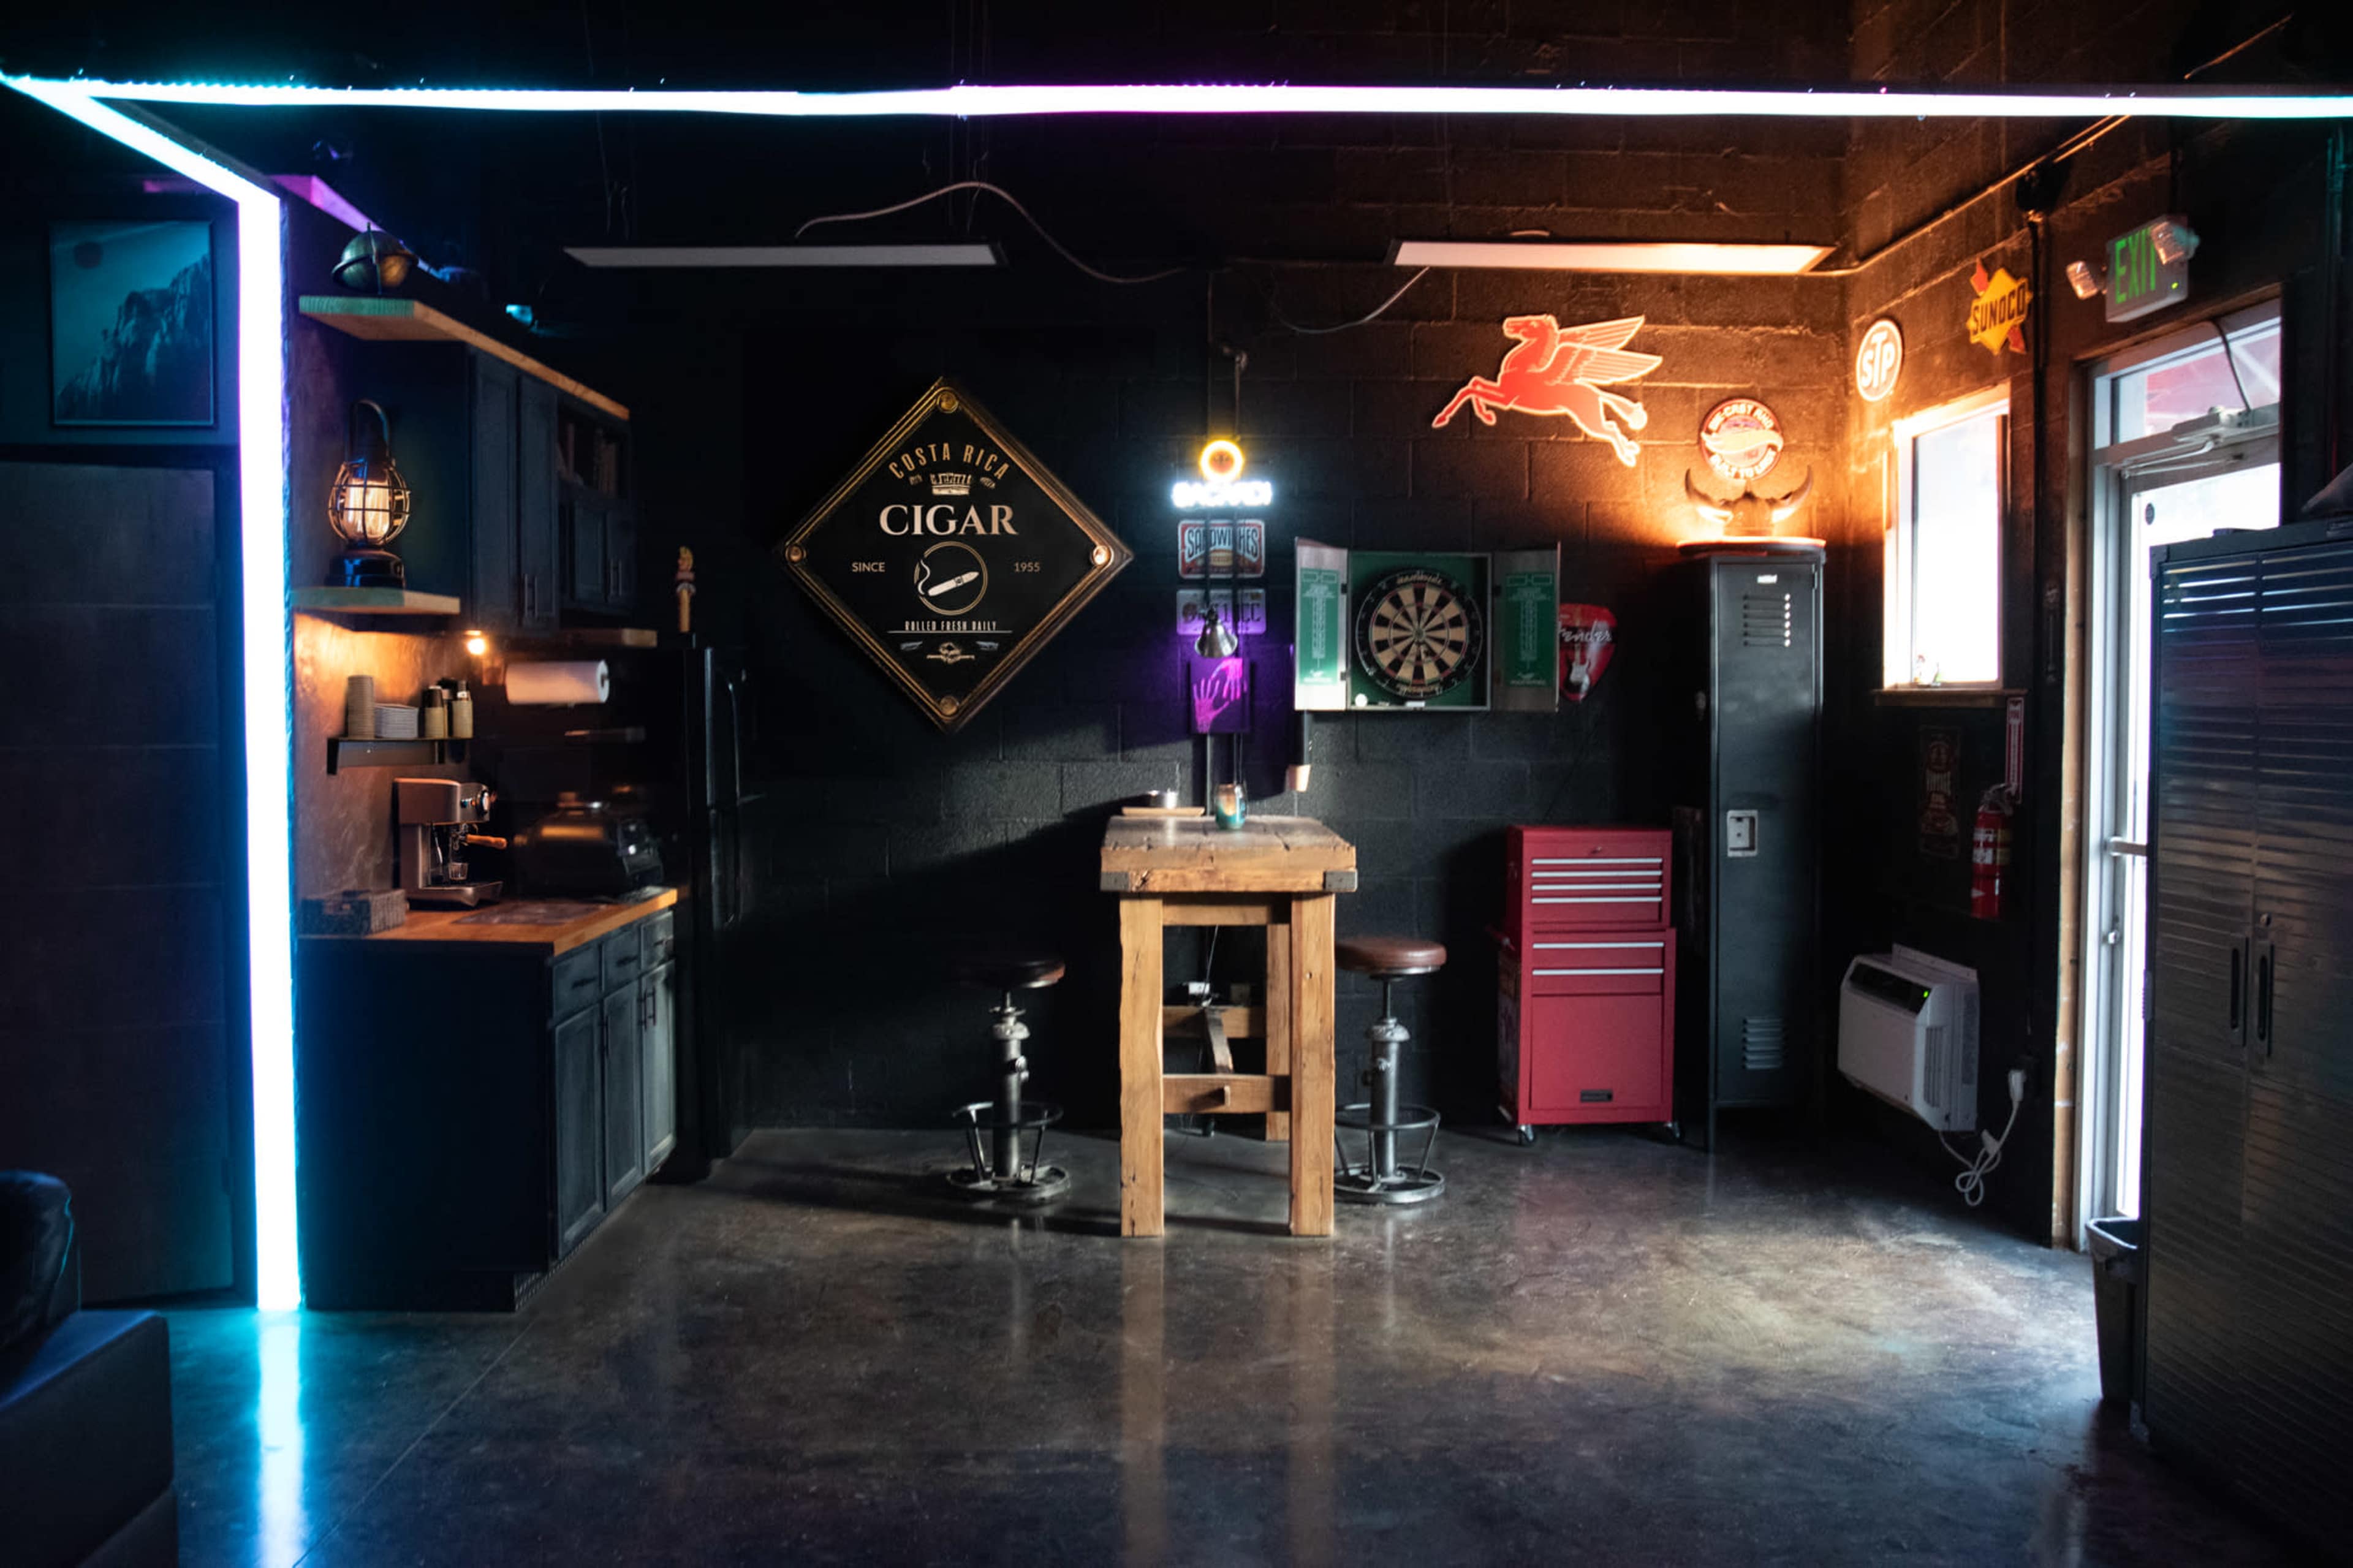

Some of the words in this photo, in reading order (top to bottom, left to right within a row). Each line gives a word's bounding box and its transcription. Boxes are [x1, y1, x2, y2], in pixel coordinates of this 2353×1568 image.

[2115, 227, 2156, 305] EXIT
[1972, 282, 2026, 336] SUNOCO
[1861, 331, 1895, 388] STP
[889, 442, 950, 479] COSTA
[963, 444, 1010, 480] RICA
[879, 504, 1018, 536] CIGAR
[1186, 527, 1259, 558] SADWIHES
[852, 562, 885, 572] SINCE
[1014, 562, 1040, 572] 1955
[904, 621, 936, 631] ROLLED
[941, 621, 968, 631] FRESH
